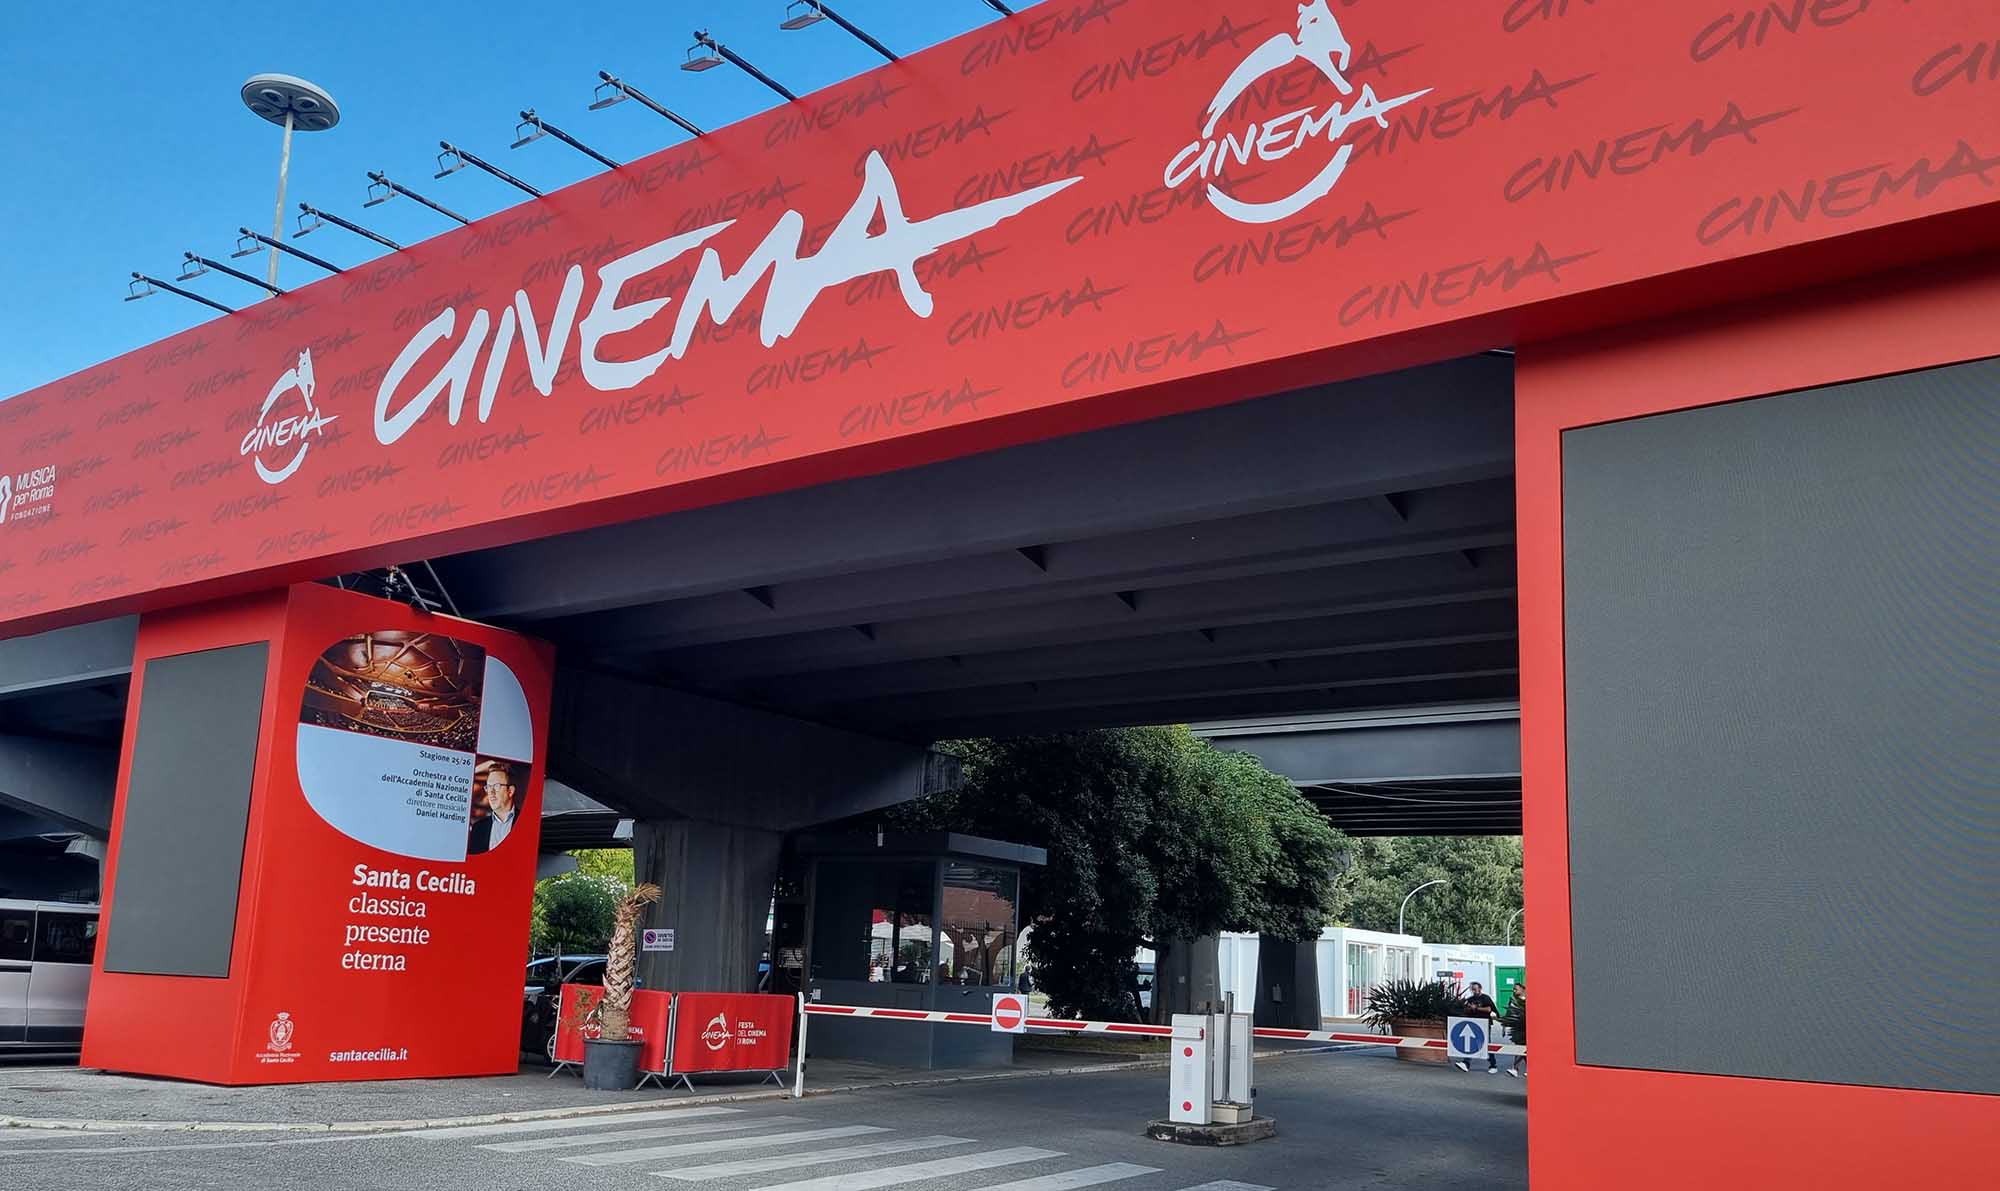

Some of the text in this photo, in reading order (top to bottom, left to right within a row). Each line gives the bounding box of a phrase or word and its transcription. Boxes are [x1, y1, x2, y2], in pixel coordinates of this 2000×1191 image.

[1071, 16, 1271, 102] CINEMA
[764, 80, 908, 150] CINEMA
[1164, 83, 1434, 188] CINEMA
[953, 134, 1137, 208] CINEMA
[1503, 101, 1805, 202] CINEMA
[601, 151, 720, 207] CINEMA
[1696, 139, 2000, 246] CINEMA
[671, 175, 806, 233] CINEMA
[461, 208, 563, 259] CINEMA
[1193, 201, 1424, 283] CINEMA
[374, 150, 1085, 446] CINEMA
[1338, 241, 1602, 327] CINEMA
[946, 277, 1129, 346] CINEMA
[746, 337, 896, 395] CINEMA
[1061, 319, 1268, 388] CINEMA
[579, 384, 704, 434] CINEMA
[839, 376, 1003, 437] CINEMA
[240, 408, 339, 455] CINEMA
[437, 424, 543, 469] CINEMA
[655, 418, 791, 476] CINEMA
[13, 484, 55, 511] per Roma
[15, 464, 56, 491] MUSICA
[317, 456, 406, 499] CINEMA
[502, 463, 617, 507] CINEMA
[209, 488, 289, 525] CINEMA
[368, 495, 471, 536] CINEMA
[412, 768, 447, 781] Orchestra
[454, 775, 470, 785] Coro
[419, 750, 471, 766] Stagione 25/26
[381, 774, 468, 793] dell'Accademia Nazionale
[406, 798, 436, 808] direttore
[415, 788, 468, 803] di Santa Cecilia
[416, 808, 466, 824] Daniel Harding
[352, 863, 476, 896] Santa Cecilia
[348, 891, 427, 918] classica
[344, 923, 430, 947] presente
[341, 949, 406, 971] eterna
[738, 1021, 754, 1029] FESTA
[329, 1048, 408, 1062] santacecilia.it
